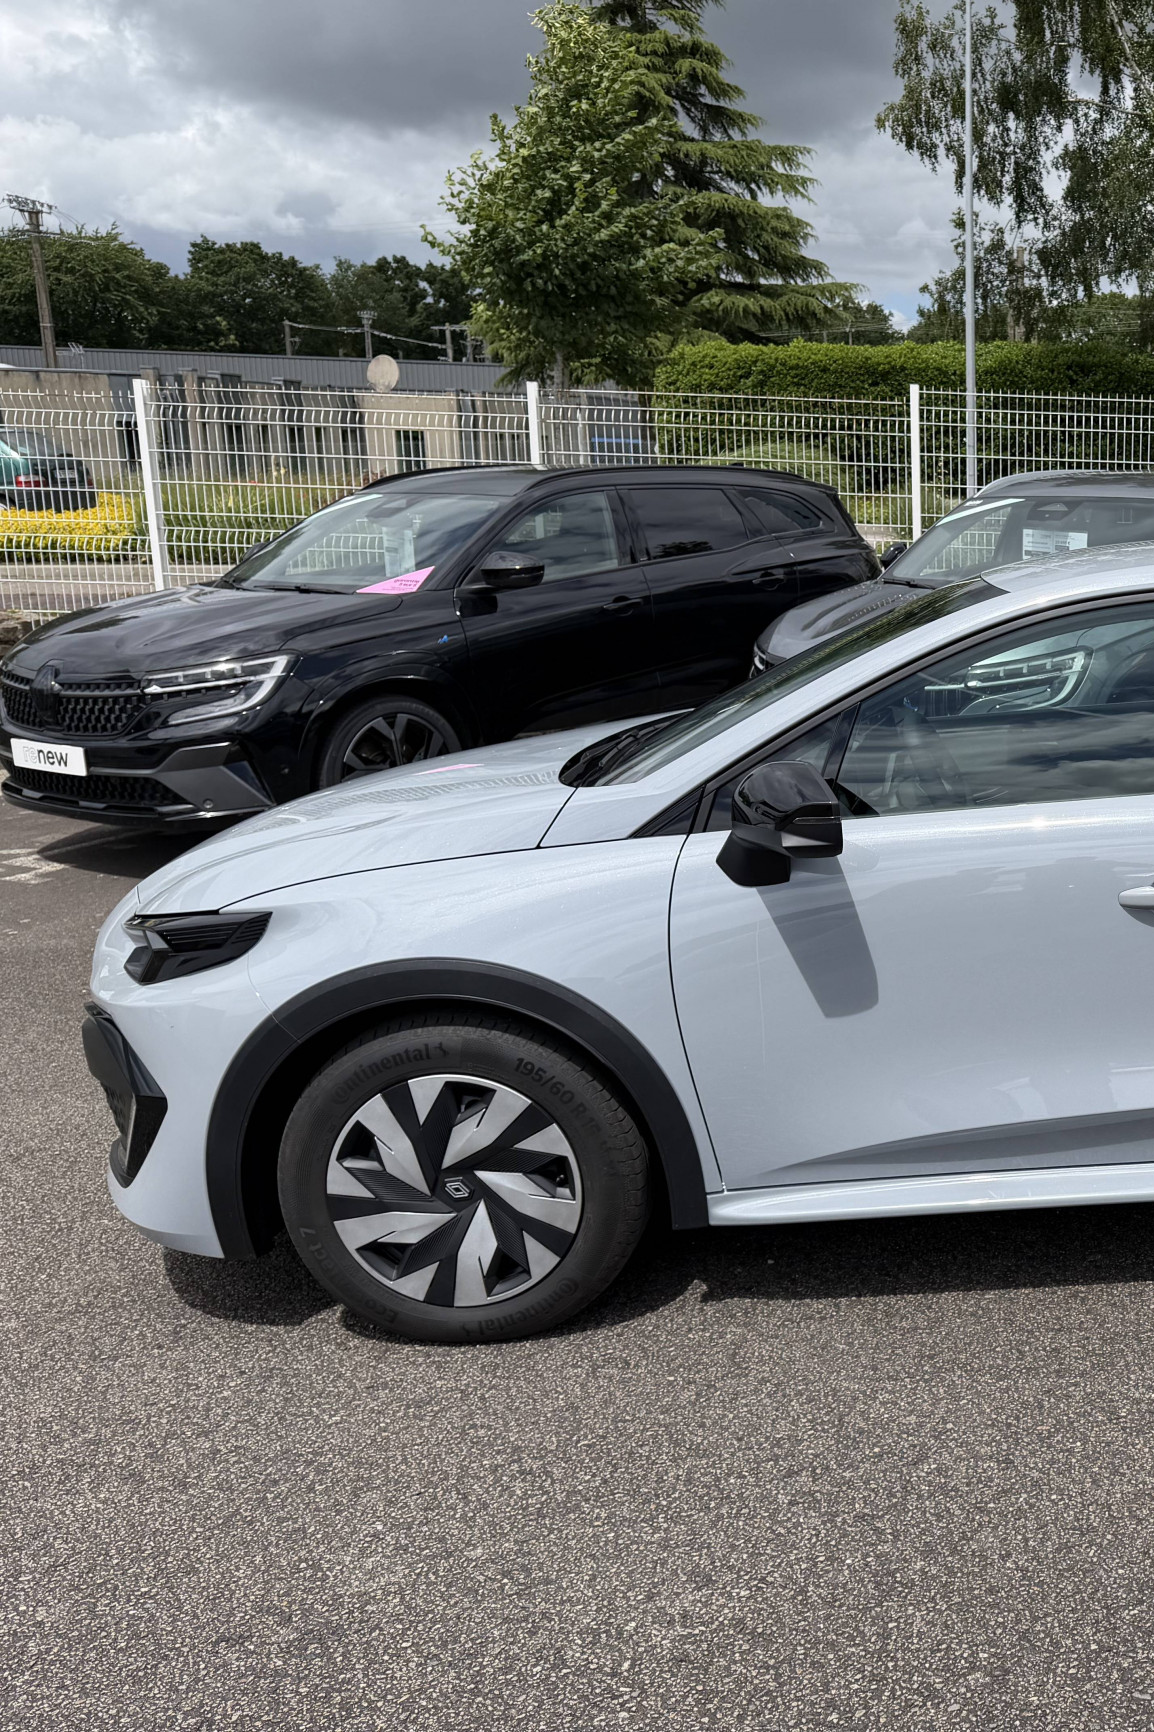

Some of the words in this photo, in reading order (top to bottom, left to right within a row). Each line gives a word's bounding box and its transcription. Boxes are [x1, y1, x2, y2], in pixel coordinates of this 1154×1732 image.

[22, 745, 68, 768] renew
[331, 1043, 432, 1105] Continental
[514, 1057, 575, 1105] 195/60
